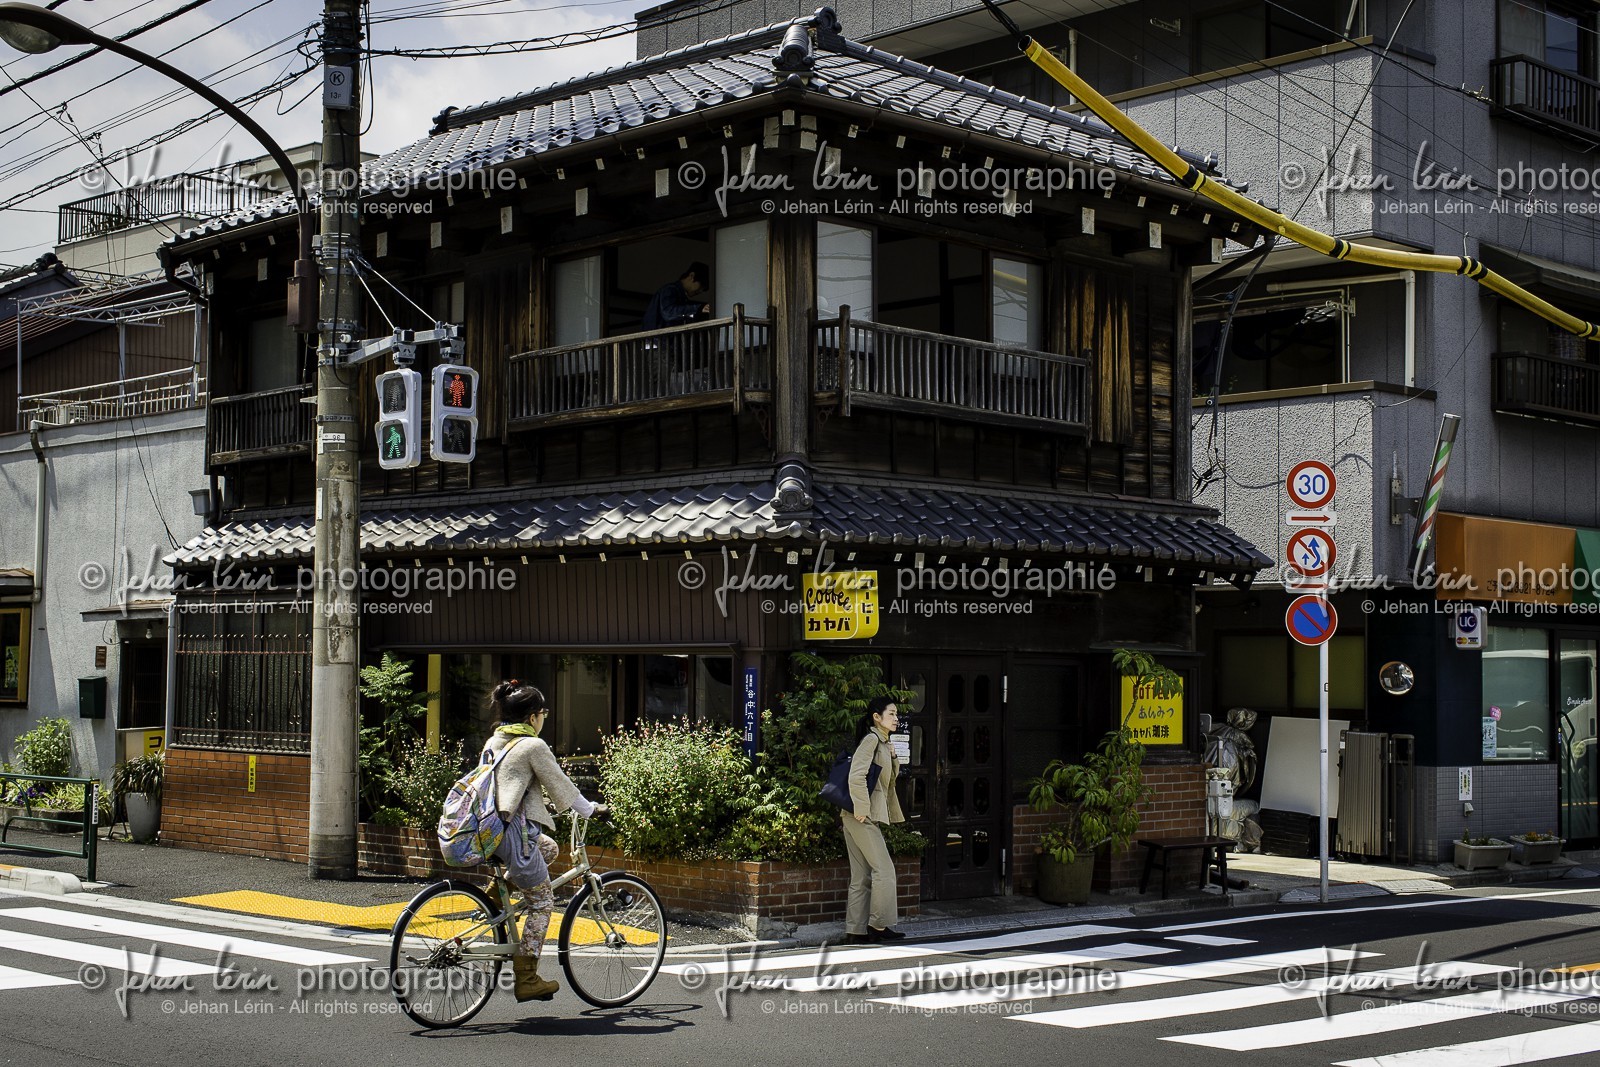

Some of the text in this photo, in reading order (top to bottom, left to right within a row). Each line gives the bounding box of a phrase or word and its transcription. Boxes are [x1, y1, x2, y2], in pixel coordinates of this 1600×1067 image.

[1298, 474, 1326, 496] 30
[806, 578, 852, 611] Coffee
[860, 578, 874, 624] コーヒー
[808, 617, 850, 632] カヤバ
[1460, 616, 1476, 627] UC
[1138, 705, 1174, 720] あんみつ
